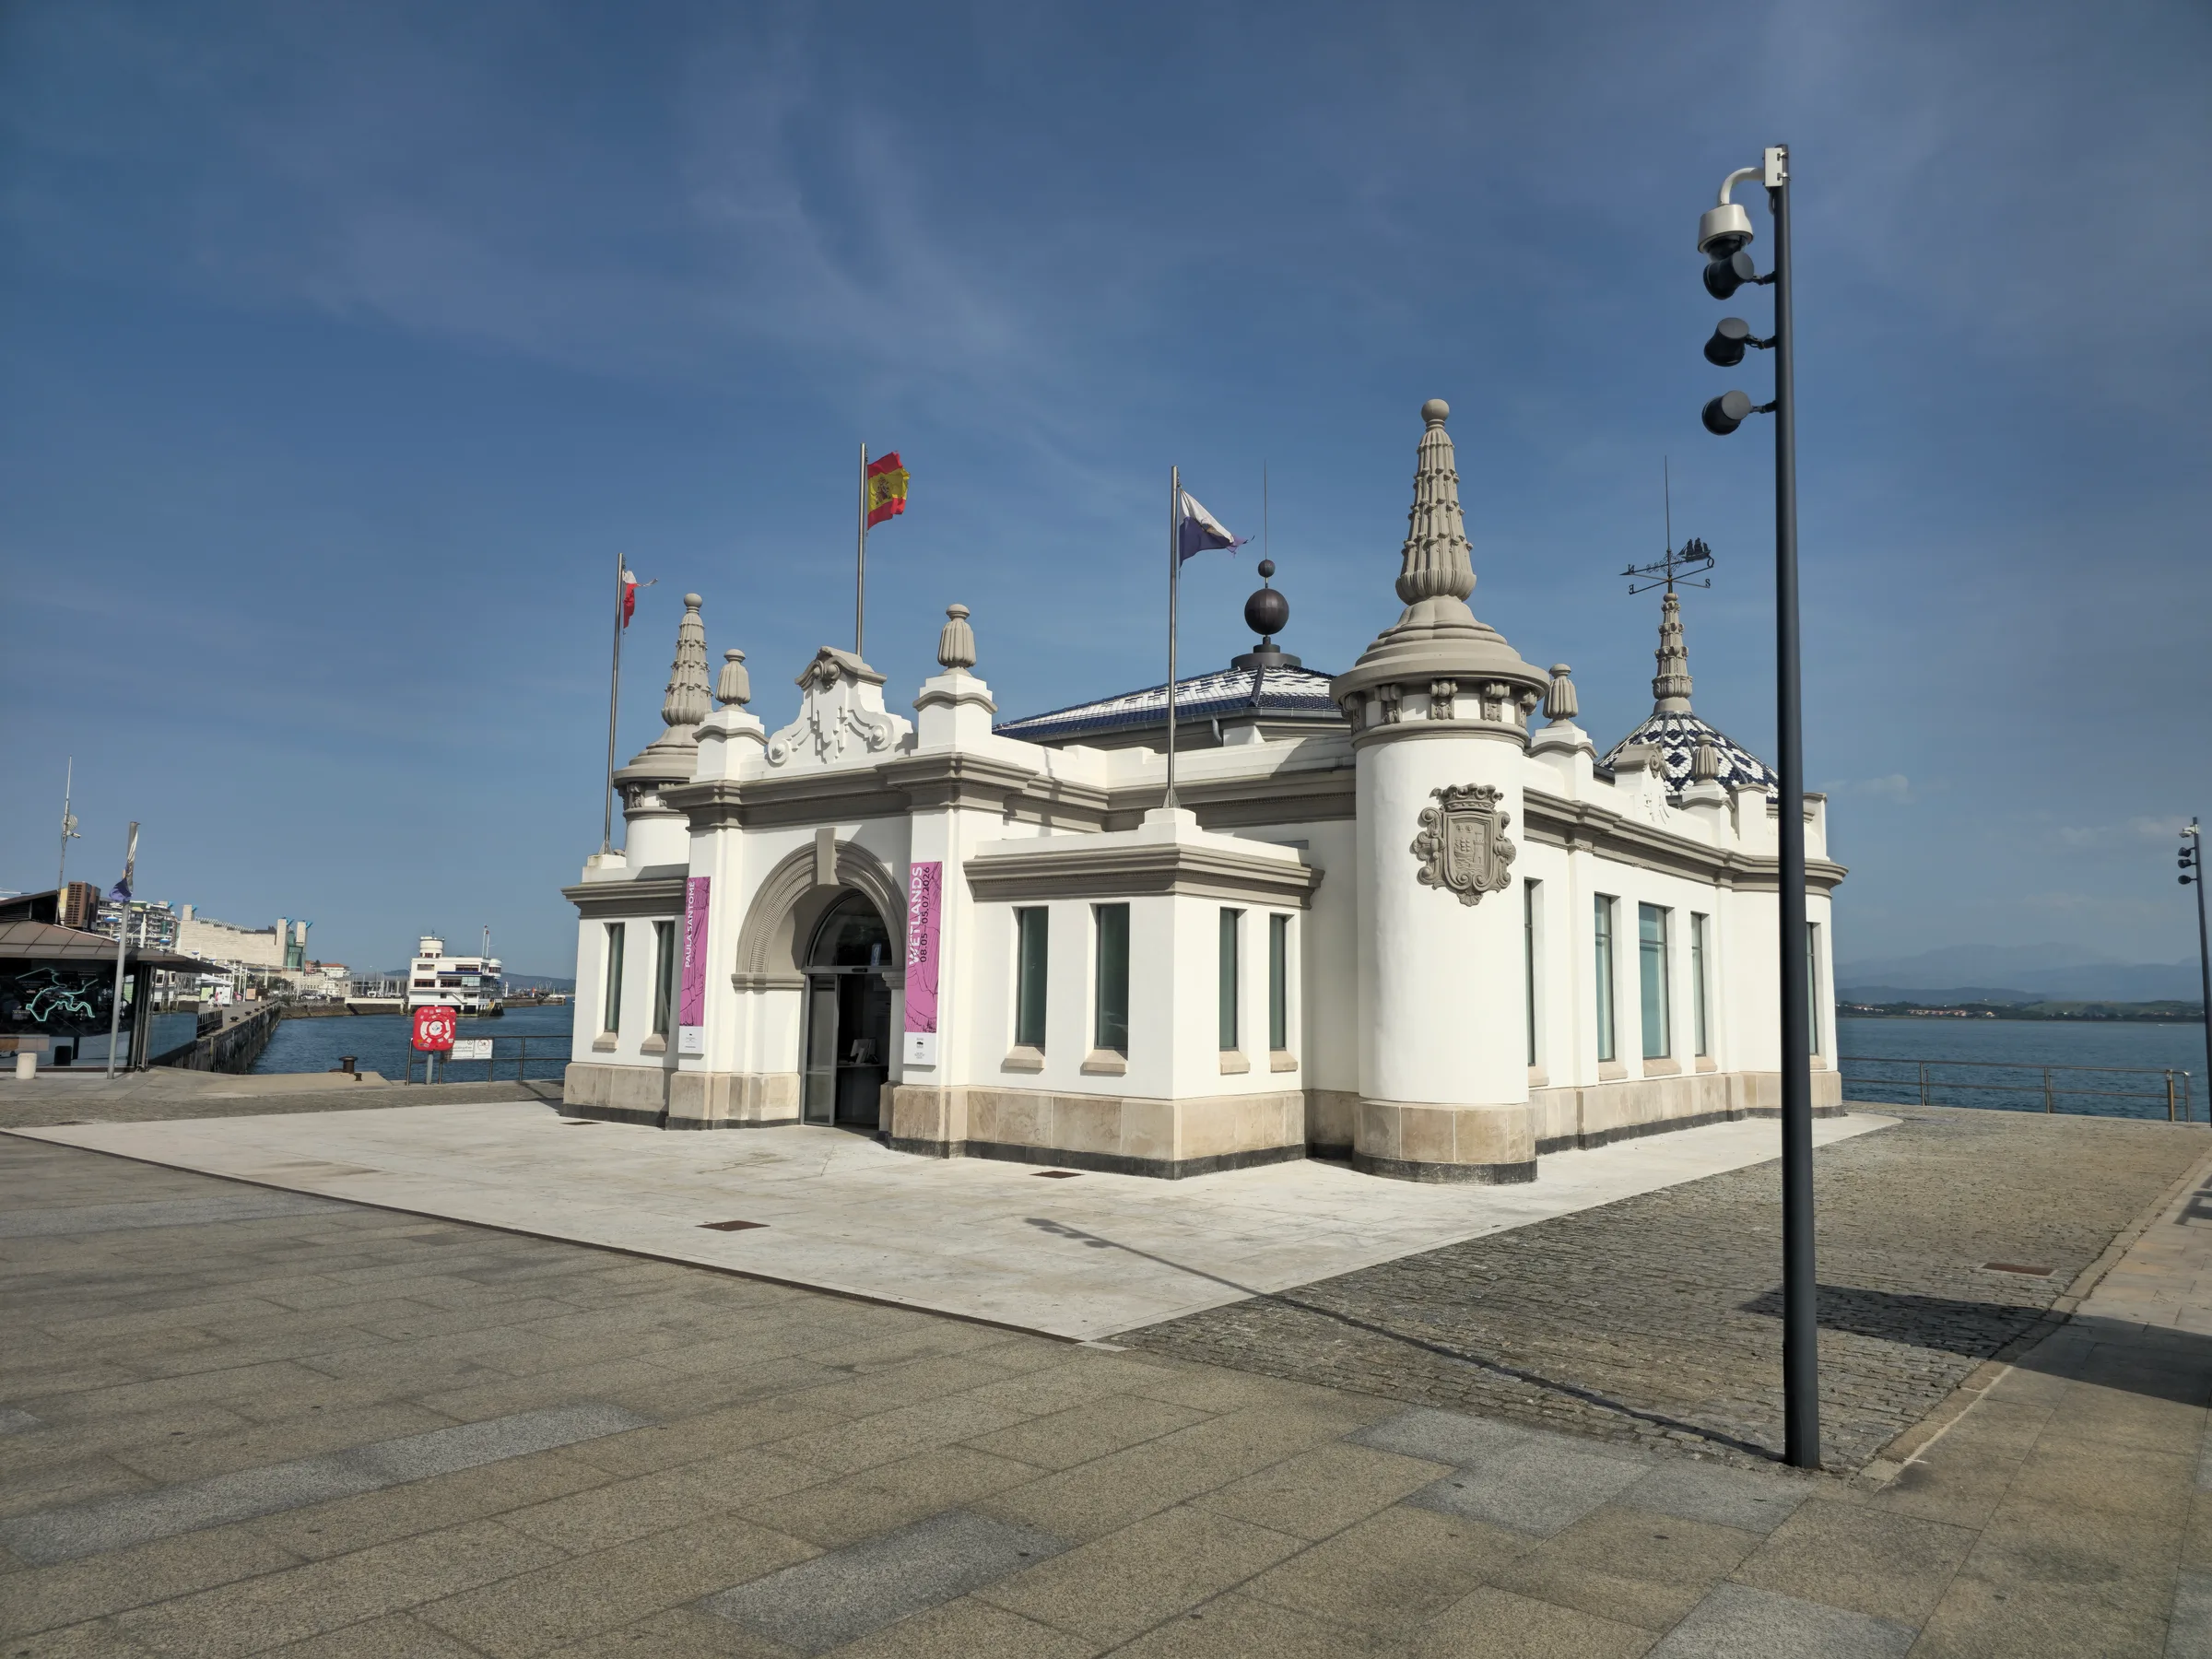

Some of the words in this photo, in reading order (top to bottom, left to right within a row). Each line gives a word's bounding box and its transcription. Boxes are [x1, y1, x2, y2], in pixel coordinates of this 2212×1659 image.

[687, 881, 695, 931] SANTOMÉ
[909, 867, 923, 965] WETLANDS
[685, 935, 693, 968] PAULA
